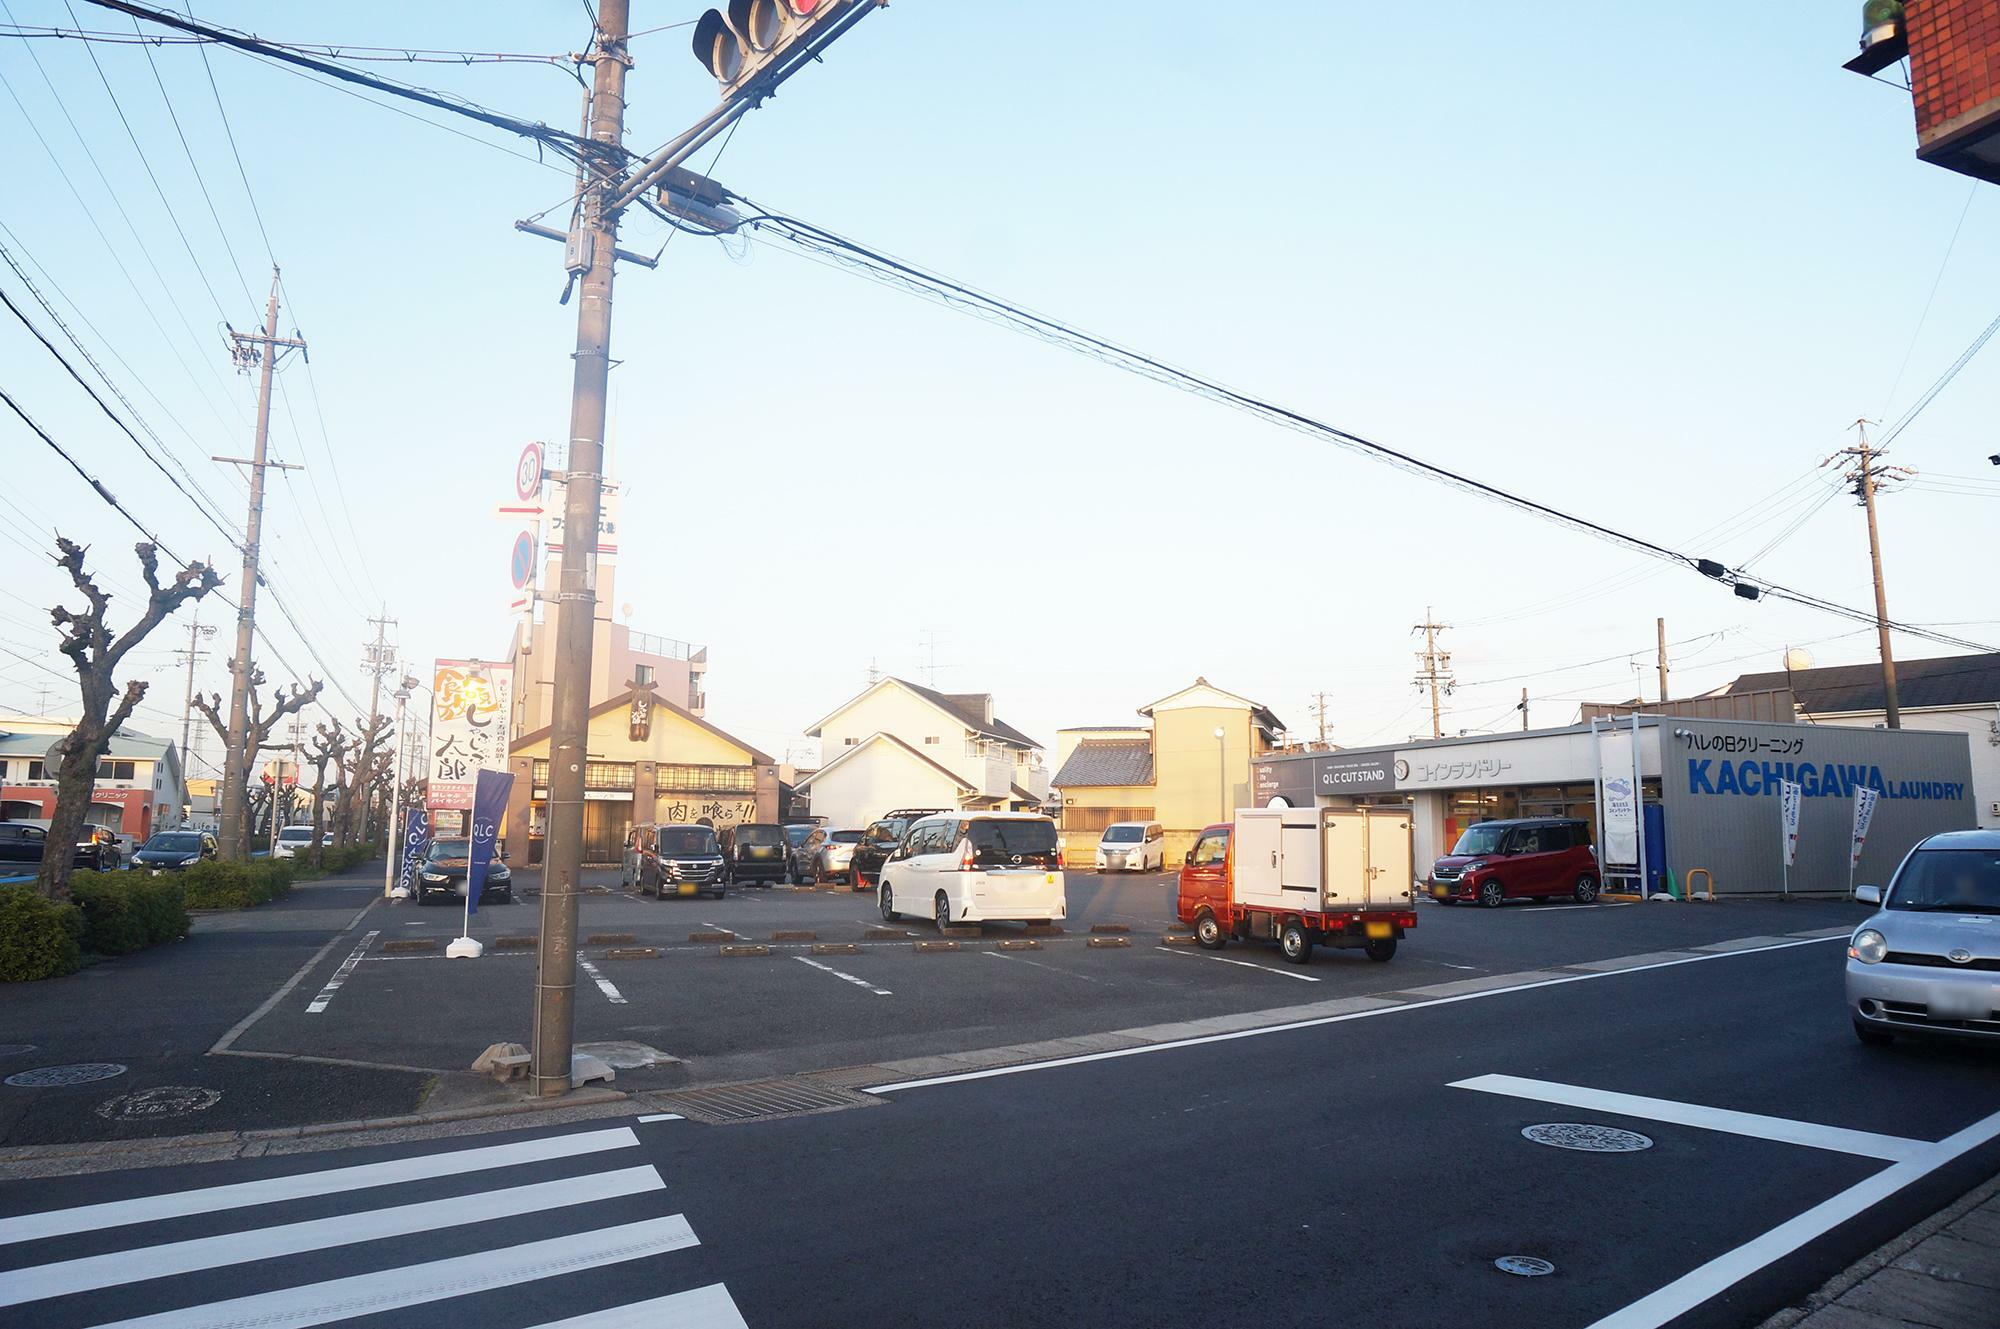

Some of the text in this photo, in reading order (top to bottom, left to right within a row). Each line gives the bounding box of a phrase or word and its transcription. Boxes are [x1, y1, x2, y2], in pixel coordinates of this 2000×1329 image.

[521, 457, 536, 486] 30
[1687, 734, 1804, 755] ハレの日クリーニング
[435, 734, 469, 780] 太郎
[1322, 773, 1340, 784] QLC
[1416, 759, 1512, 783] コインランドリー
[1688, 758, 1964, 801] KACHIGAWA LAUNDRY
[473, 823, 494, 837] QLC
